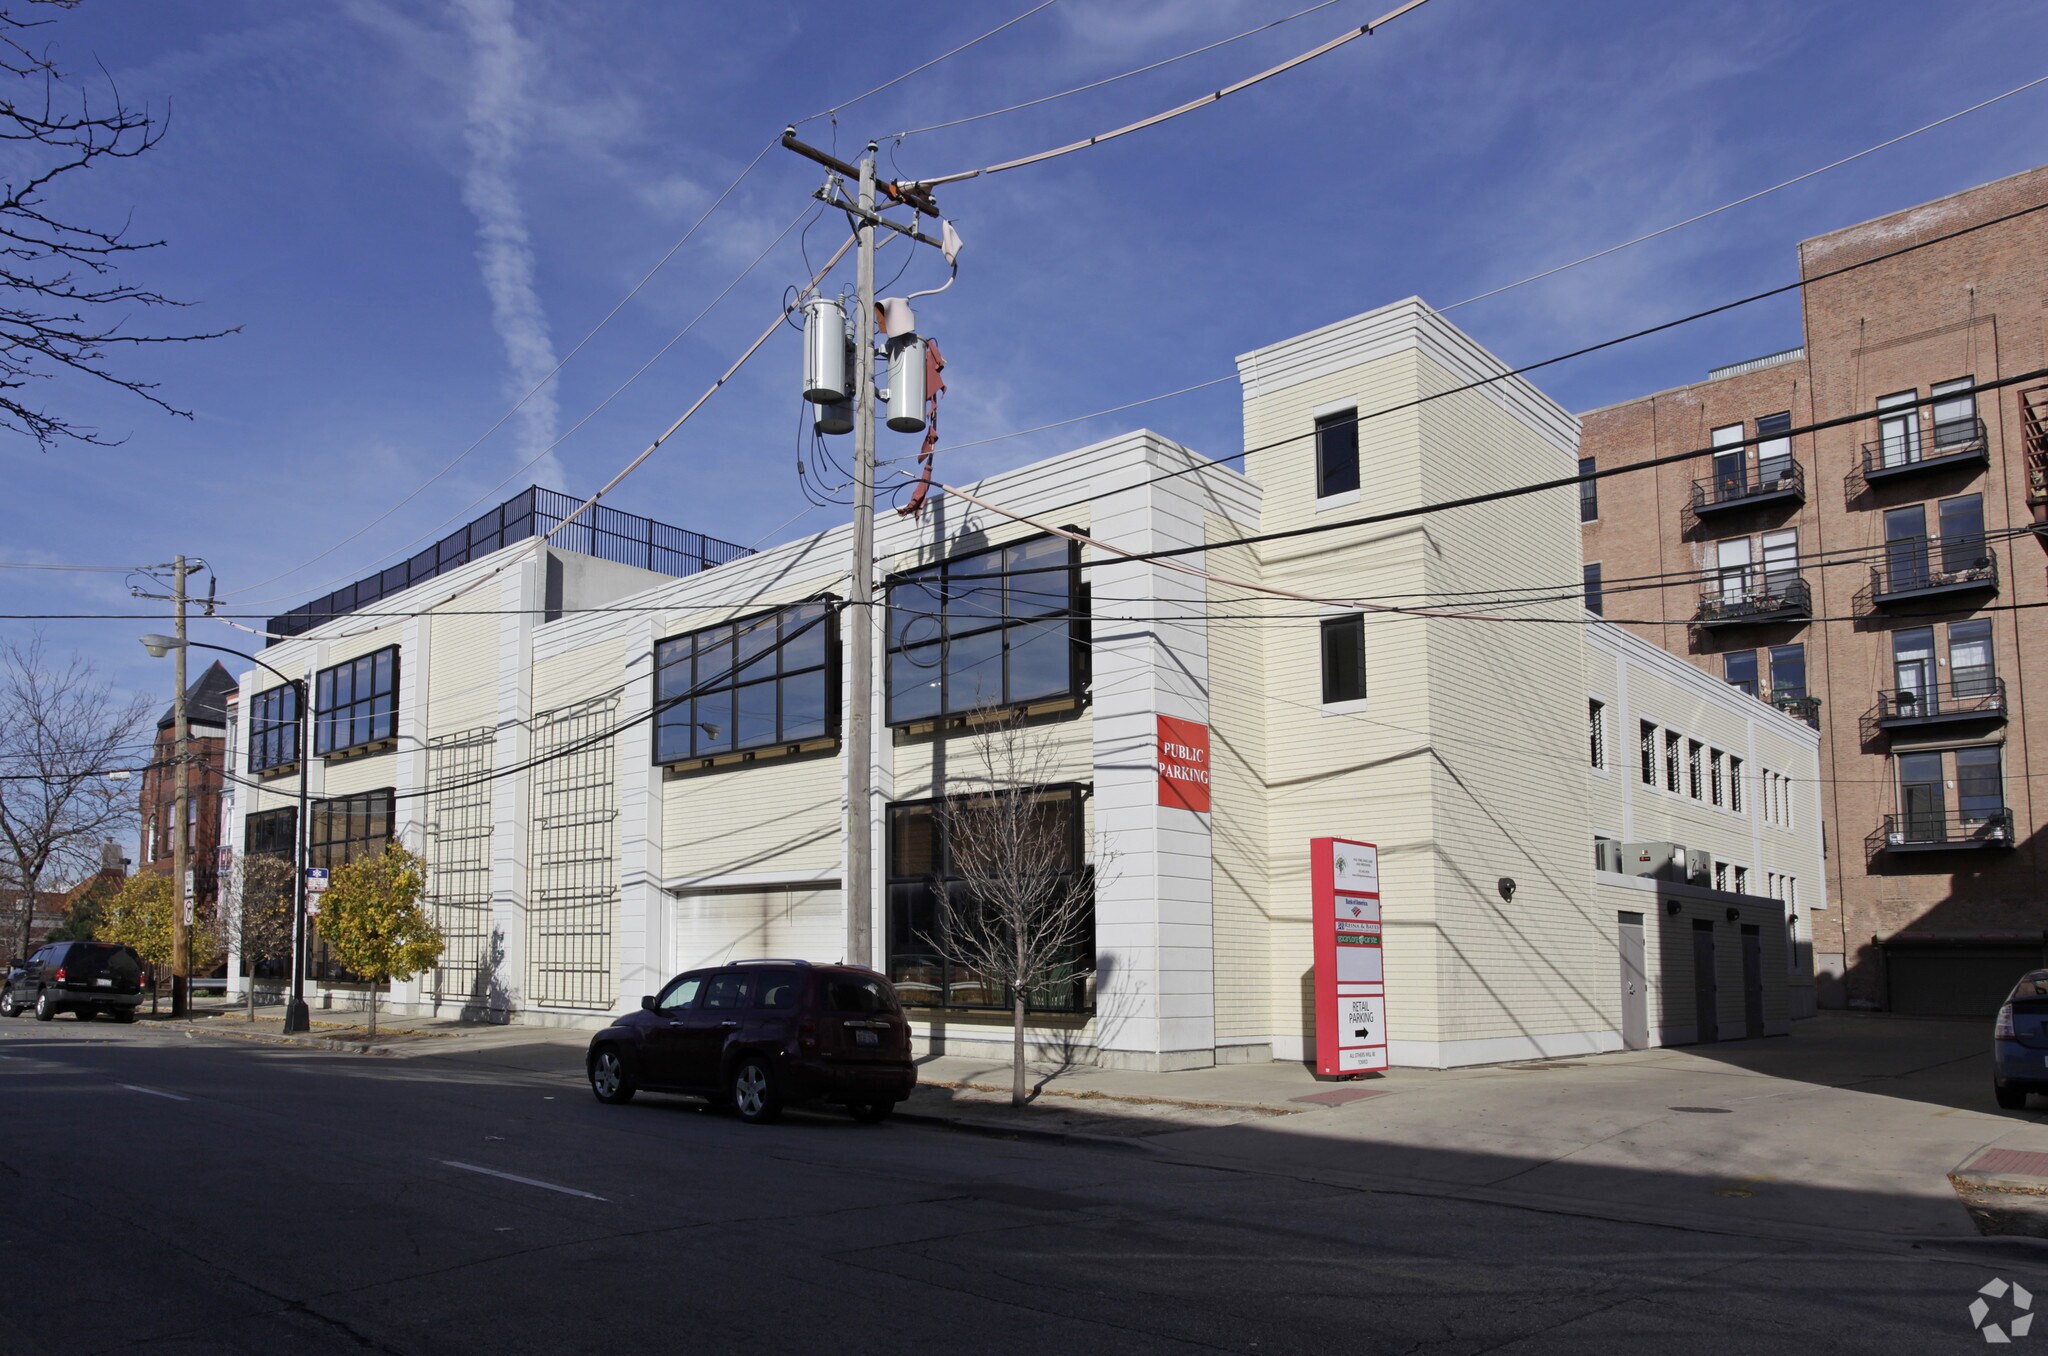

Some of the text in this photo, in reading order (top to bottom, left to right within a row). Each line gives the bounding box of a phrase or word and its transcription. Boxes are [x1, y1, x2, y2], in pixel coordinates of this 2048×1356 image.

[1163, 742, 1204, 763] PUBLIC
[1158, 762, 1209, 784] PARKING
[1352, 1001, 1370, 1012] RETAIL
[1349, 1012, 1374, 1023] PARKING
